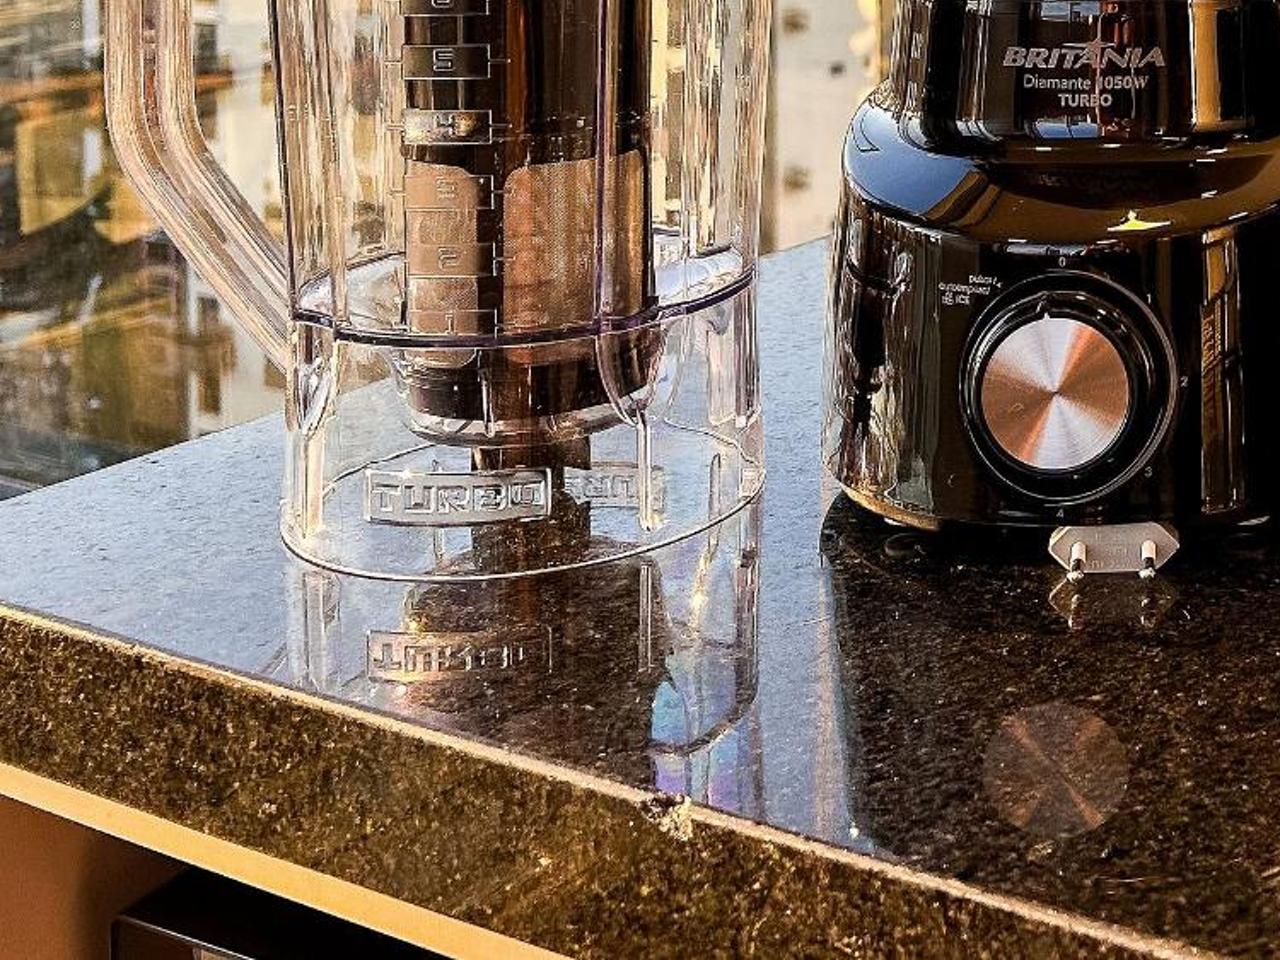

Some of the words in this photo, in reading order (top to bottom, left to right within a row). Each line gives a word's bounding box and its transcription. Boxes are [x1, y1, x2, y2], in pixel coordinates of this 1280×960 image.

[432, 48, 454, 72] 5
[1023, 73, 1092, 90] Diamante
[1096, 74, 1149, 90] 1050W
[1058, 92, 1113, 108] TURBO
[1180, 375, 1190, 388] 2
